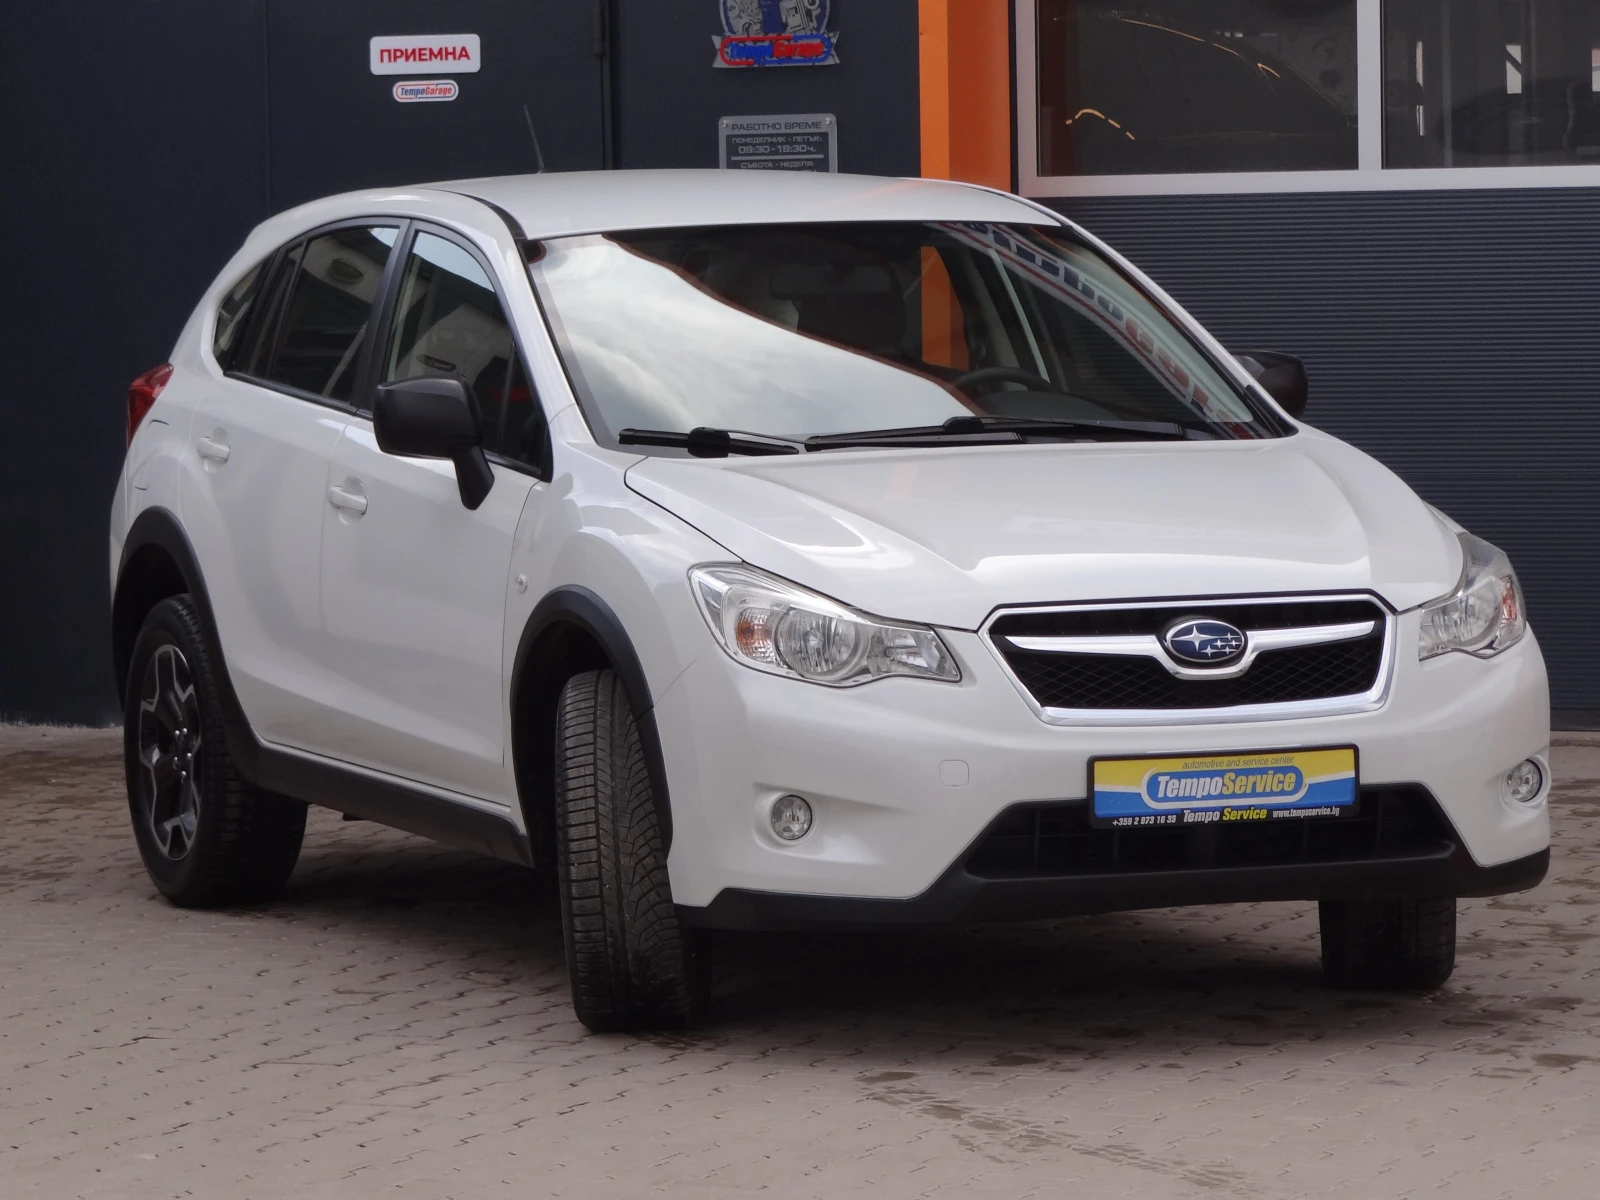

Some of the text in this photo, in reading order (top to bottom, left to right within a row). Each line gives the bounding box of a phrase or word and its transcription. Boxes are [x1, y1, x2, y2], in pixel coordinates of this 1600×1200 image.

[380, 46, 471, 63] ПРИЕМНА
[400, 86, 453, 98] TempoGarage
[731, 121, 822, 131] РАБОТНО ВРЕМЕ
[740, 161, 773, 169] СЪБОТА
[1182, 756, 1295, 769] automotive and service center
[1157, 770, 1297, 799] TempoService
[1112, 806, 1340, 827] +359 2 973 16 35 Tempo Service www.temposervice.bg
